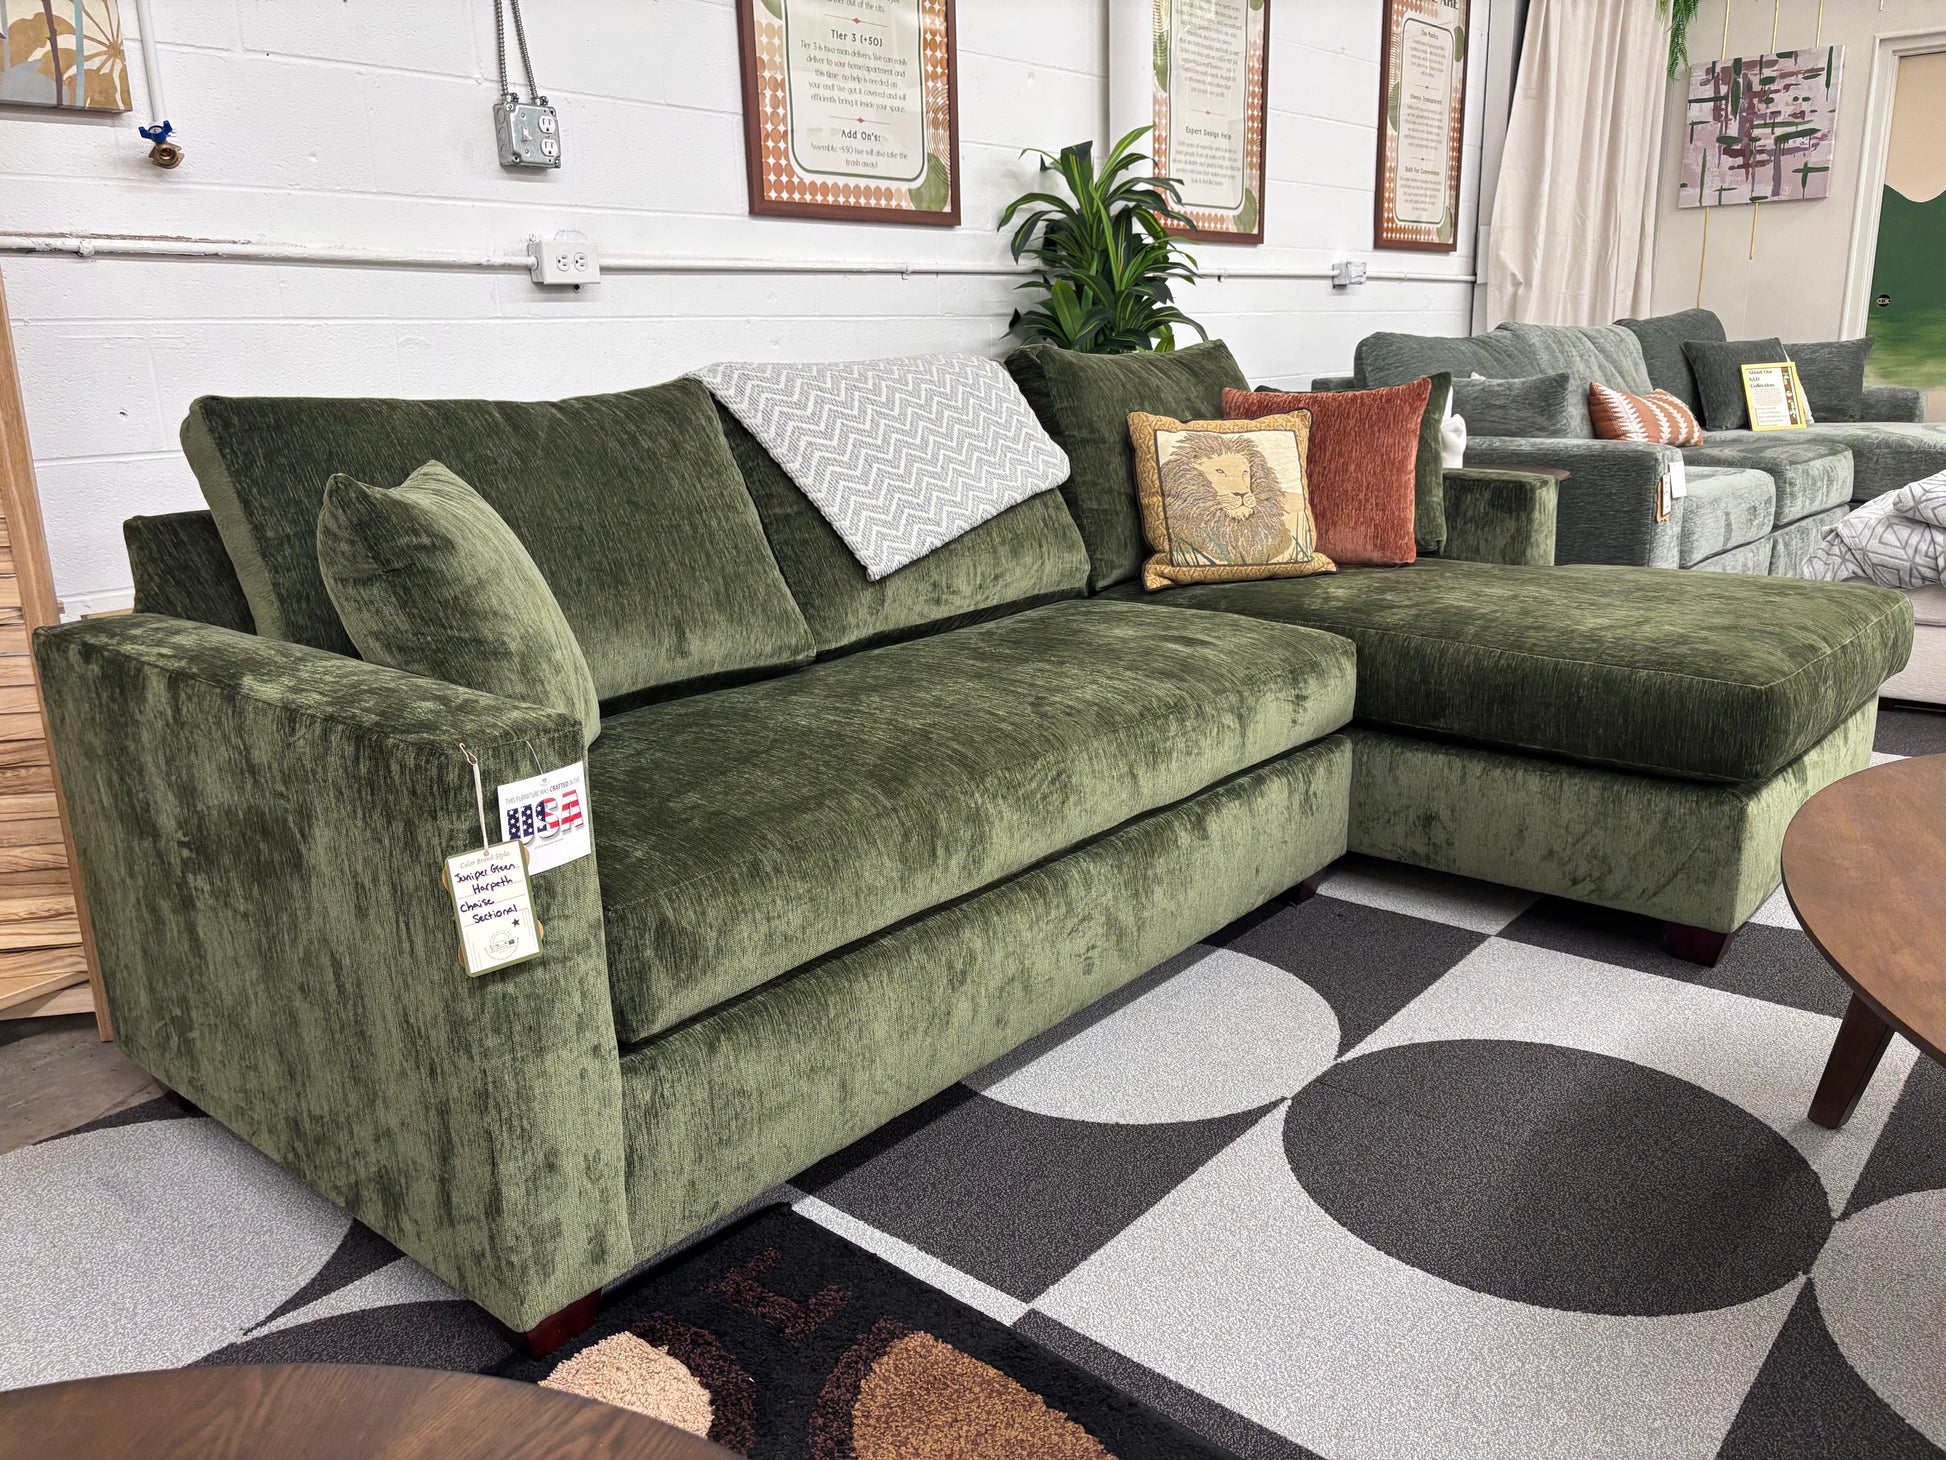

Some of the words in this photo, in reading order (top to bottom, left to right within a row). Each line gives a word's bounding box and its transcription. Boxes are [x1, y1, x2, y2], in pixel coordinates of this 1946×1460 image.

[831, 29, 847, 41] Tier
[851, 33, 857, 42] 3
[860, 34, 883, 47] (+50)
[801, 40, 811, 49] Tier
[824, 44, 835, 54] two
[837, 47, 850, 56] man
[872, 52, 882, 61] We
[883, 56, 893, 64] can
[806, 54, 824, 65] deliver
[826, 57, 833, 66] to
[834, 60, 846, 69] your
[894, 69, 906, 78] and
[815, 68, 825, 77] this
[850, 73, 863, 84] help
[868, 78, 889, 87] needed
[890, 81, 898, 89] on
[808, 81, 821, 90] your
[836, 83, 847, 92] We
[847, 87, 857, 96] got
[864, 89, 886, 99] covered
[887, 91, 897, 100] and
[898, 93, 907, 101] will
[810, 93, 837, 104] efficiently
[838, 96, 854, 107] bring
[860, 99, 875, 108] inside
[875, 102, 887, 111] your
[841, 129, 858, 140] Add
[861, 131, 881, 142] On's:
[1186, 126, 1202, 136] Expert
[1203, 129, 1219, 139] Design
[1221, 132, 1231, 141] Help
[845, 158, 861, 167] trash
[865, 147, 873, 157] will
[874, 149, 886, 158] also
[886, 150, 898, 159] take
[899, 152, 909, 161] the
[505, 796, 515, 805] THIS
[516, 790, 540, 802] FURNITURE
[540, 787, 549, 796] WAS
[550, 780, 569, 793] CRAFTED
[507, 789, 584, 847] USA
[454, 869, 488, 883] Juniper
[490, 863, 516, 874] Green
[472, 875, 514, 895] Harpeth
[472, 903, 518, 924] Sectional
